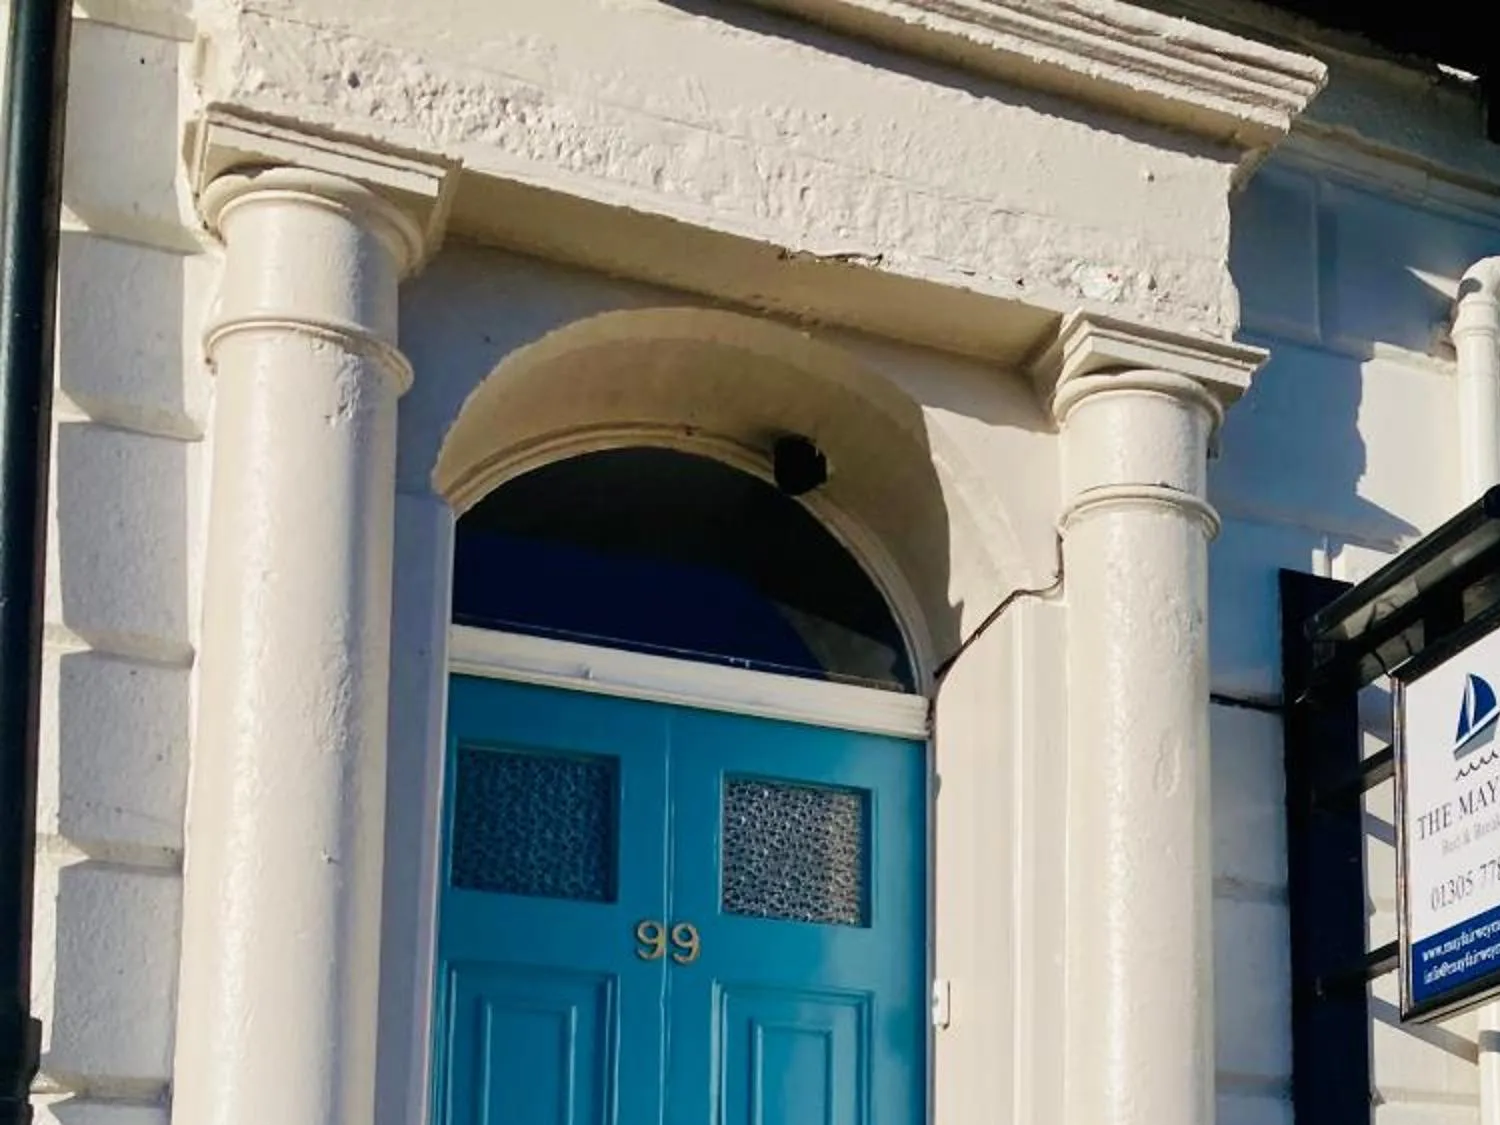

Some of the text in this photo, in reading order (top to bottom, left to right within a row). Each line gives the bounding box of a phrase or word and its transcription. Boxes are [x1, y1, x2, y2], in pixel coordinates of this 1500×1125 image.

[1417, 802, 1452, 840] THE
[1431, 869, 1474, 911] 01305
[637, 920, 700, 965] 99
